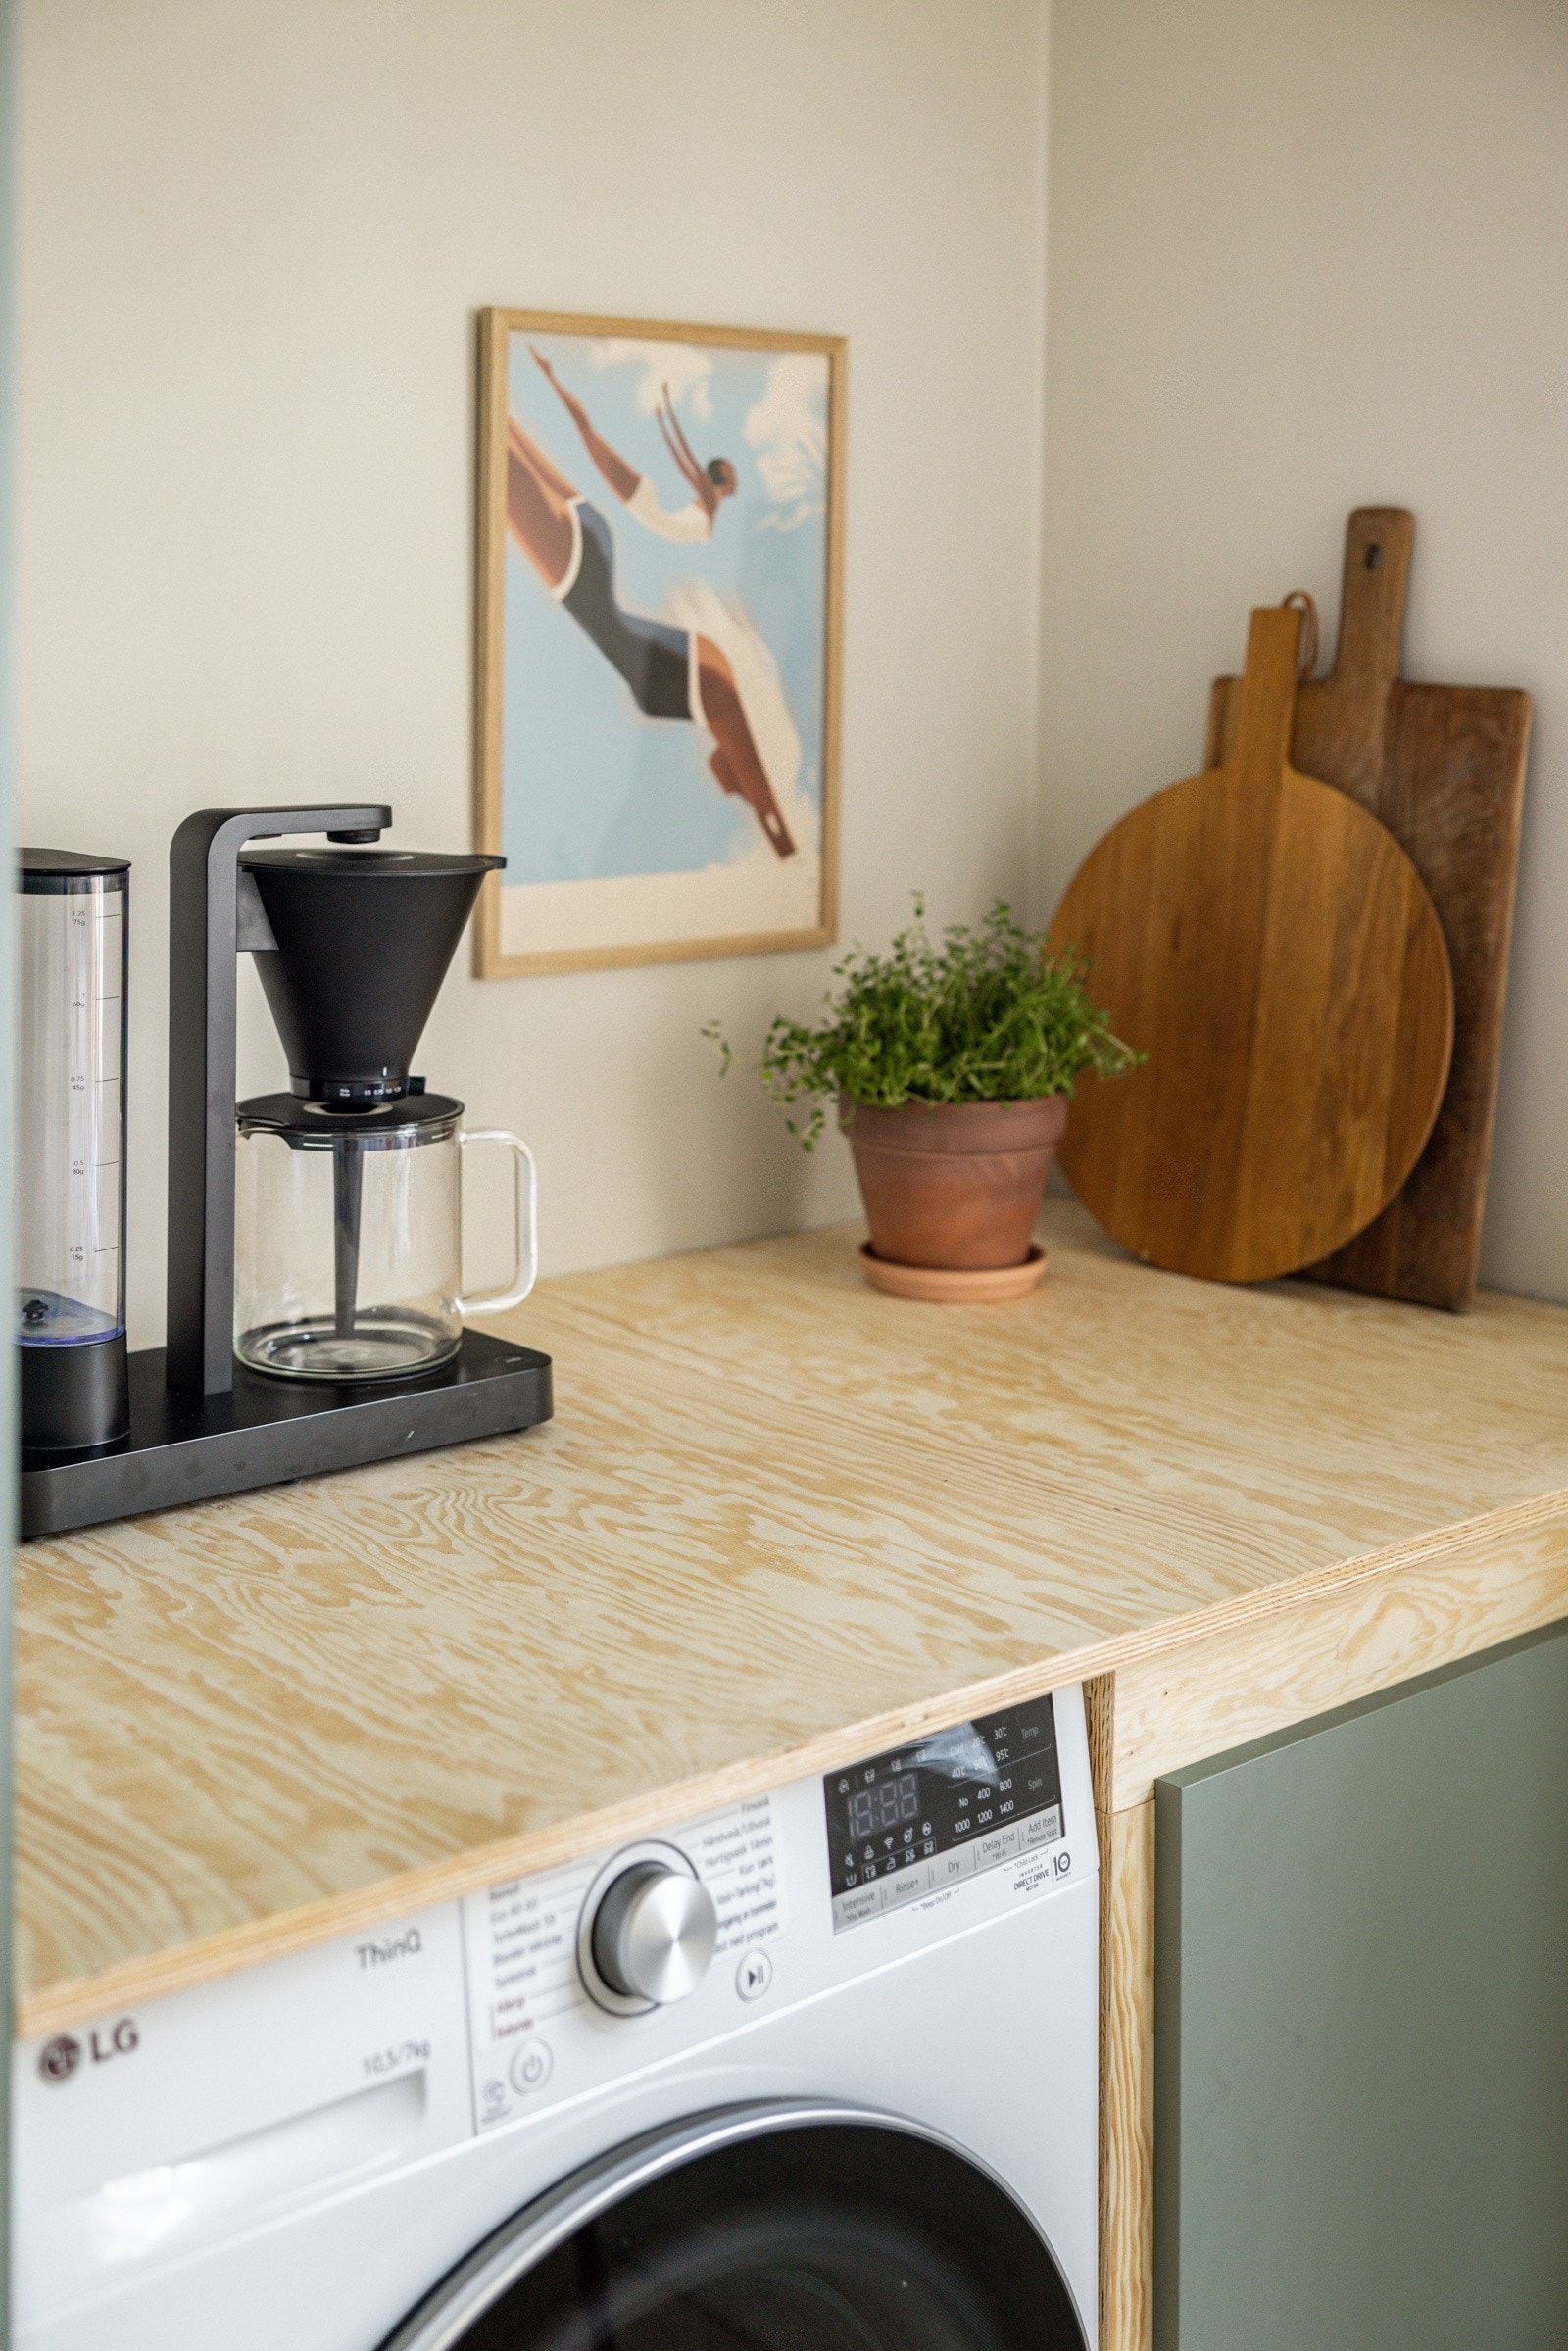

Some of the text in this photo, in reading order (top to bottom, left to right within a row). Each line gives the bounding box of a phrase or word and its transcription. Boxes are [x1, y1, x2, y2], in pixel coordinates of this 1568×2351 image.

[977, 1788, 991, 1800] 400
[1000, 1777, 1043, 1792] 800 Spin
[977, 1809, 993, 1824] 1200
[1000, 1800, 1014, 1815] 1400
[955, 1818, 971, 1834] 1000
[1027, 1815, 1057, 1835] Add Item
[982, 1831, 1015, 1854] Delay End
[948, 1861, 960, 1874] Dry
[1054, 1851, 1071, 1876] 10
[1013, 1868, 1050, 1891] DIRECT DRIVE
[843, 1890, 875, 1911] Intensive
[356, 1927, 421, 1971] ThinQ
[88, 2017, 139, 2065] LG
